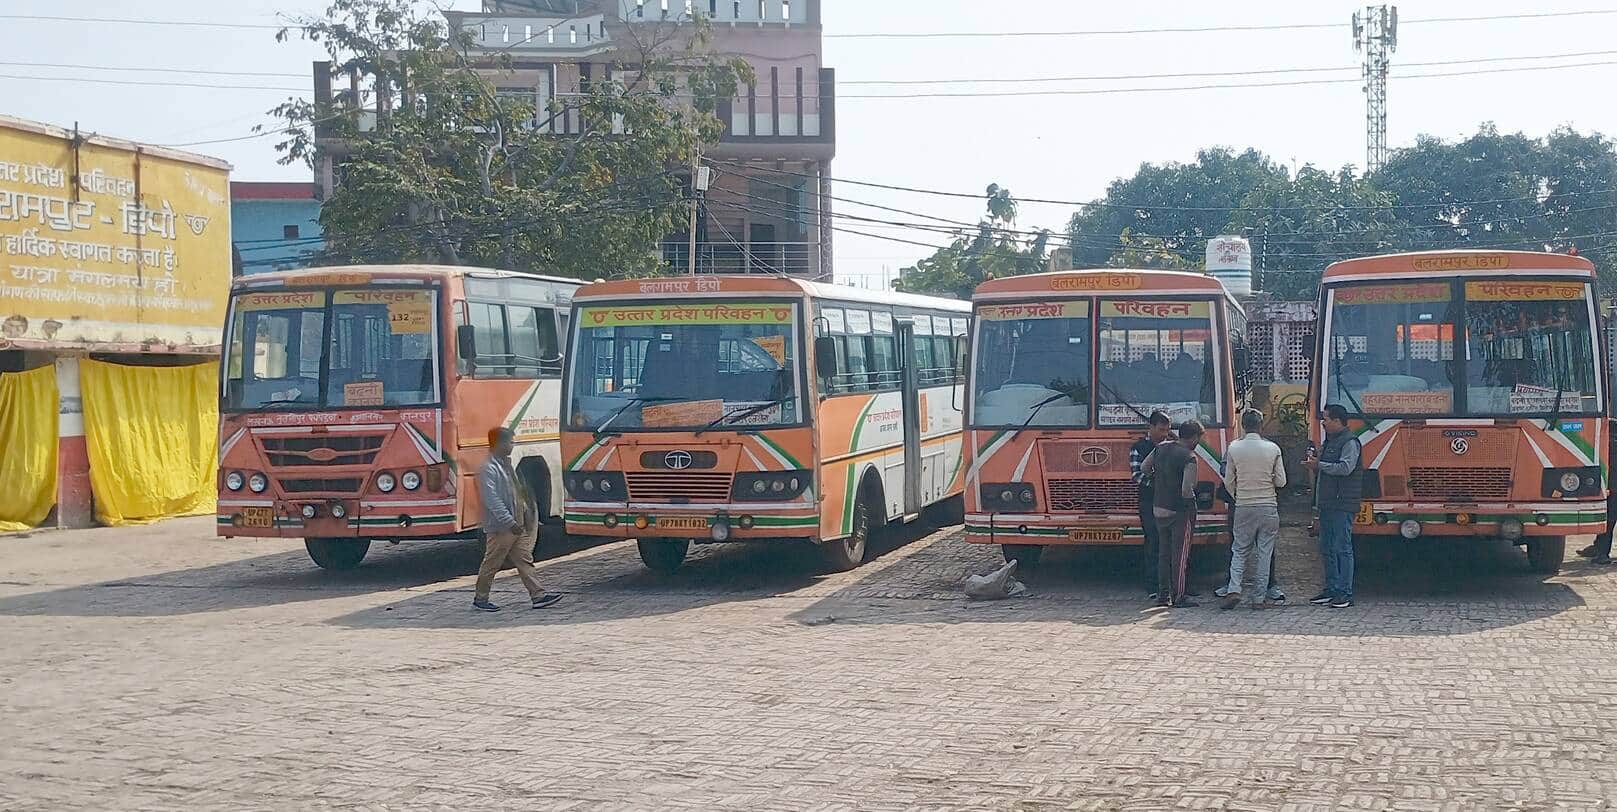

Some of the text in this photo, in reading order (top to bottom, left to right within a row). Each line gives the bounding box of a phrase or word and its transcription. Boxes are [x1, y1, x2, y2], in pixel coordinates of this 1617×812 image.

[5, 226, 58, 257] हार्दिक
[58, 239, 114, 262] स्वागत
[613, 304, 766, 321] उत्तर प्रदेश परिवहन
[1024, 302, 1064, 317] प्रदेश
[1113, 299, 1192, 317] परिवहन
